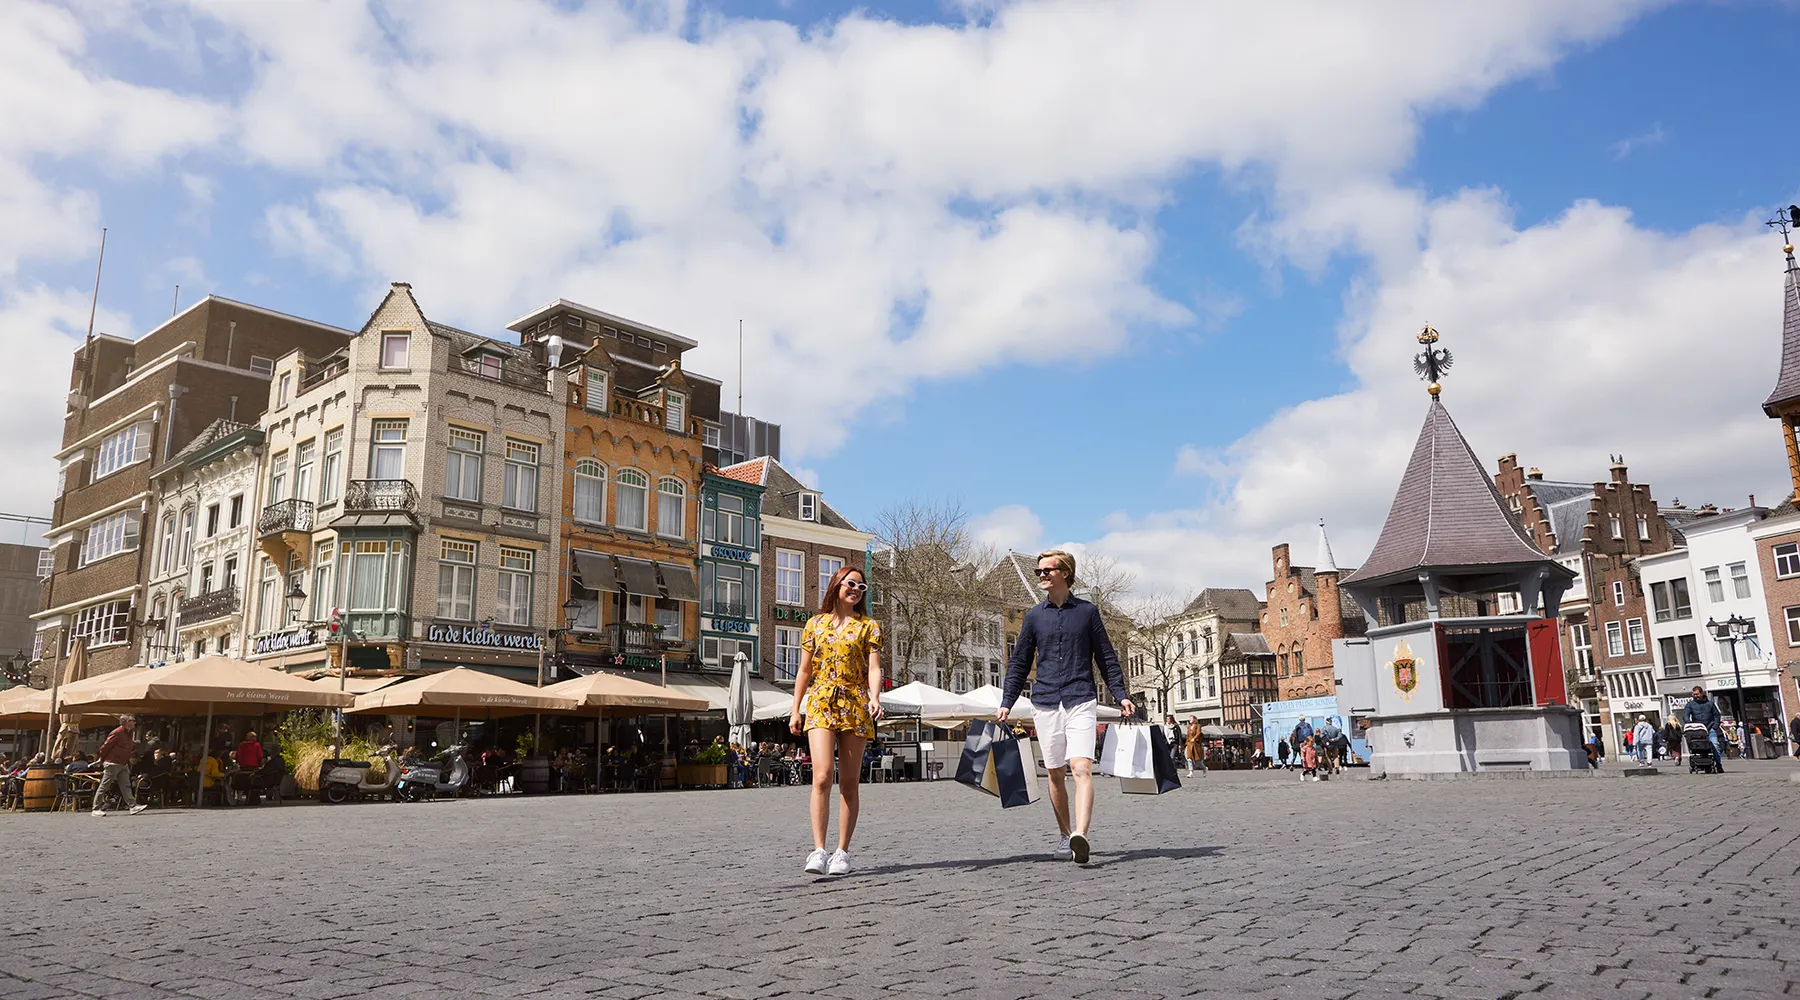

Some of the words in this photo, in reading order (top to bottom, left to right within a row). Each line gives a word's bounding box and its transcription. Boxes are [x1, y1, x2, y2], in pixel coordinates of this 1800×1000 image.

[776, 607, 788, 619] De
[445, 625, 459, 642] de
[504, 632, 544, 649] werelt
[626, 655, 672, 668] Heinekn
